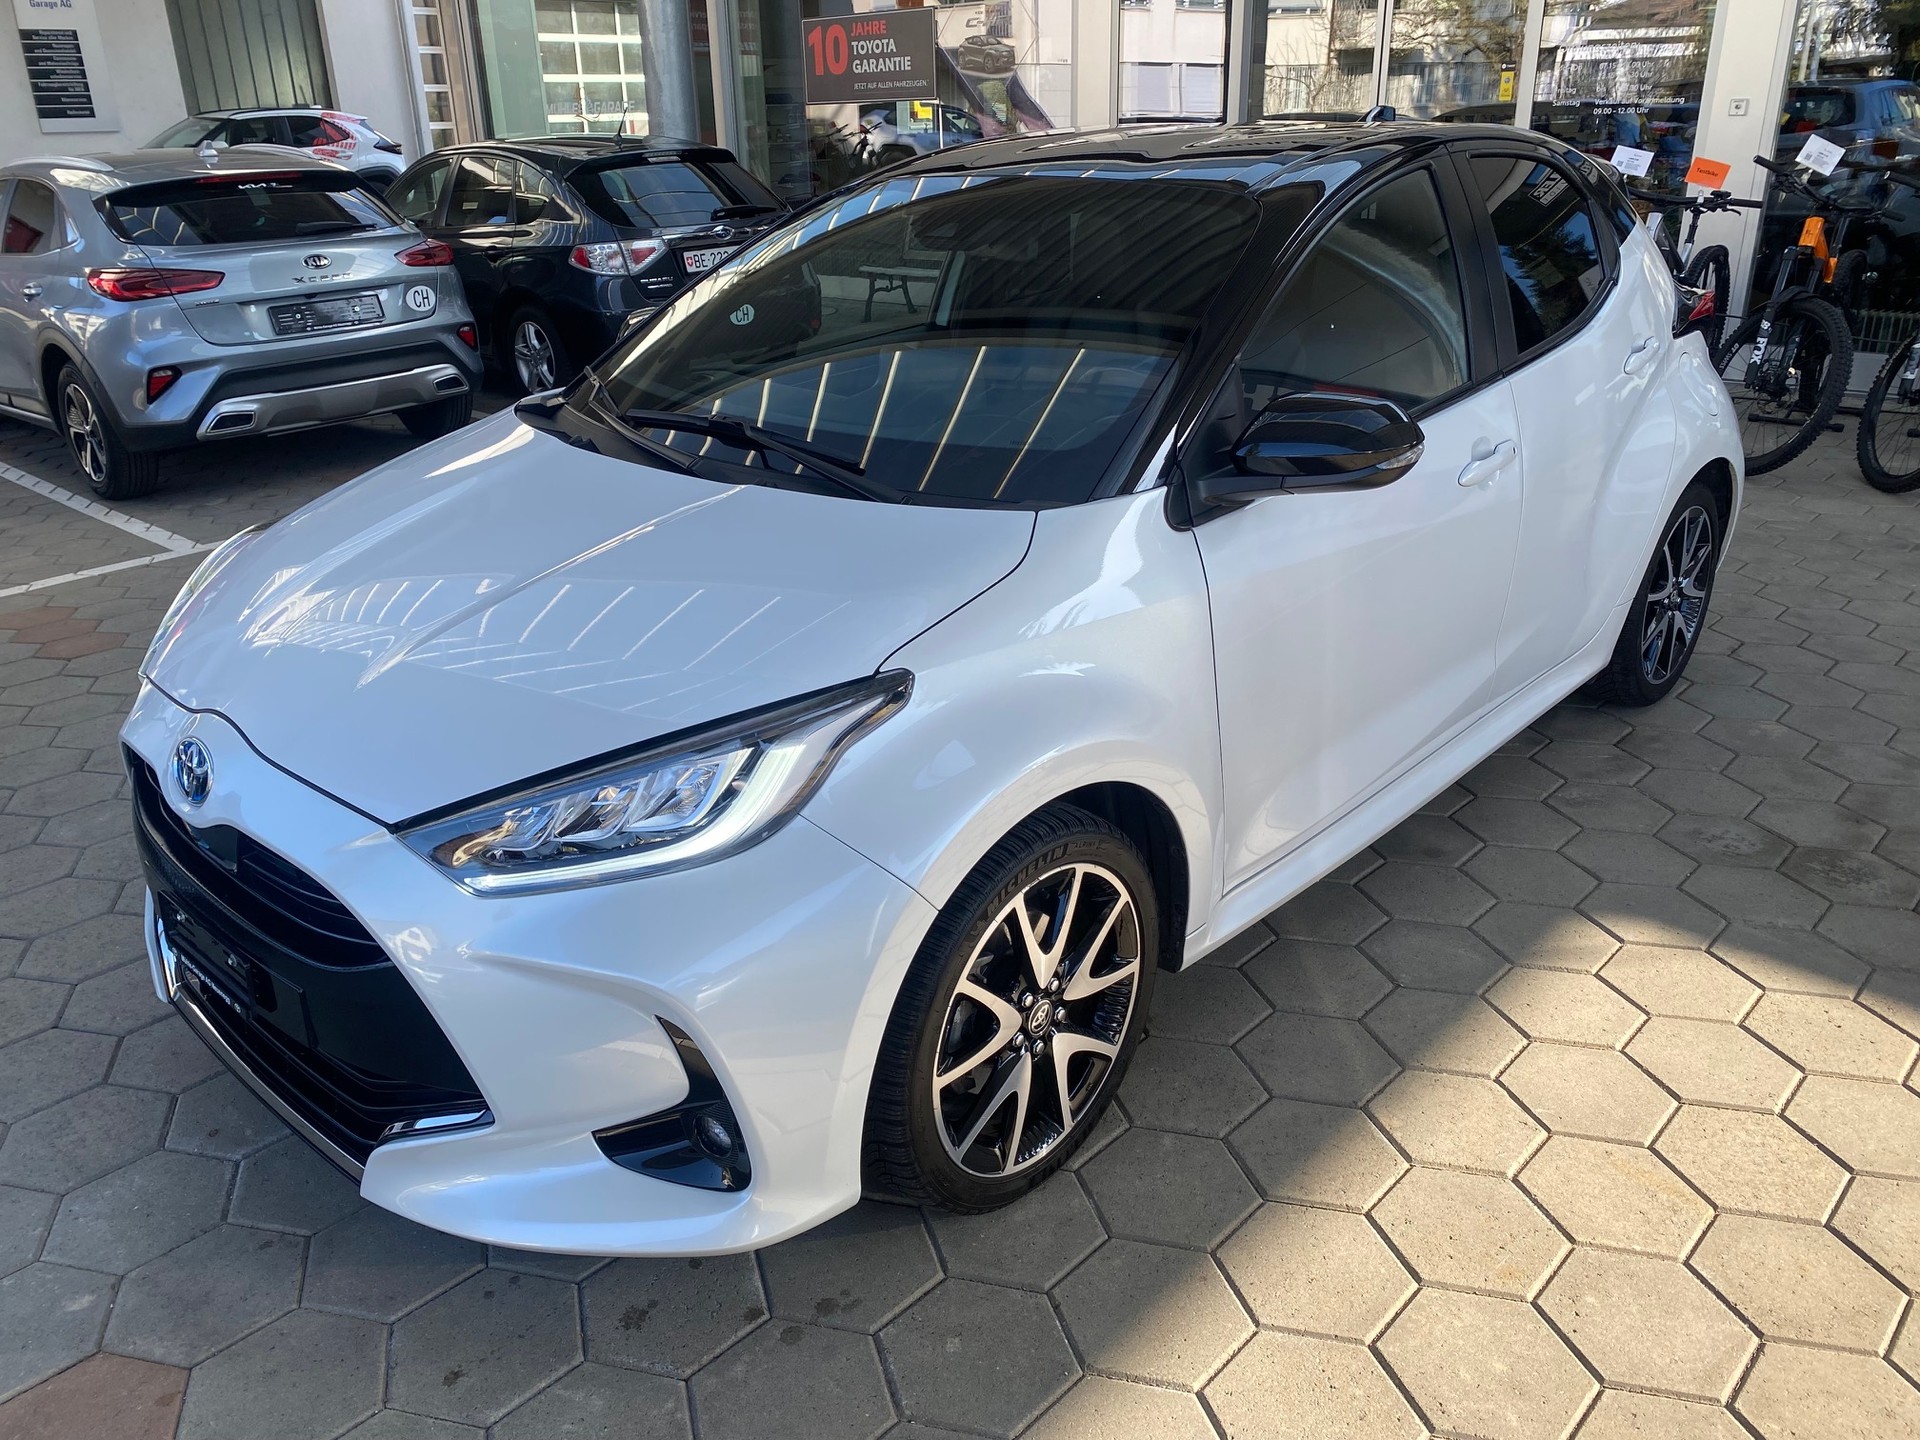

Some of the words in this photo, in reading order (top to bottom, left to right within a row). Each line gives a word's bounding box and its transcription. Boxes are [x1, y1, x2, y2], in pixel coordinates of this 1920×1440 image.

[29, 0, 58, 9] Garage
[60, 0, 72, 8] AG
[851, 20, 887, 36] JAHRE
[808, 24, 849, 76] 10
[851, 38, 896, 55] TOYOTA
[852, 56, 911, 73] GARANTIE
[853, 82, 867, 90] JETZT
[878, 81, 893, 89] ALLEN
[1552, 99, 1580, 107] Samstag
[1593, 107, 1612, 115] 09.00
[1618, 106, 1636, 114] 12.00
[1637, 106, 1650, 114] Uhr
[306, 256, 329, 266] KIA
[413, 288, 431, 308] CH
[735, 303, 750, 323] CH
[1749, 337, 1769, 365] FOX
[987, 843, 1070, 917] MICHELIN
